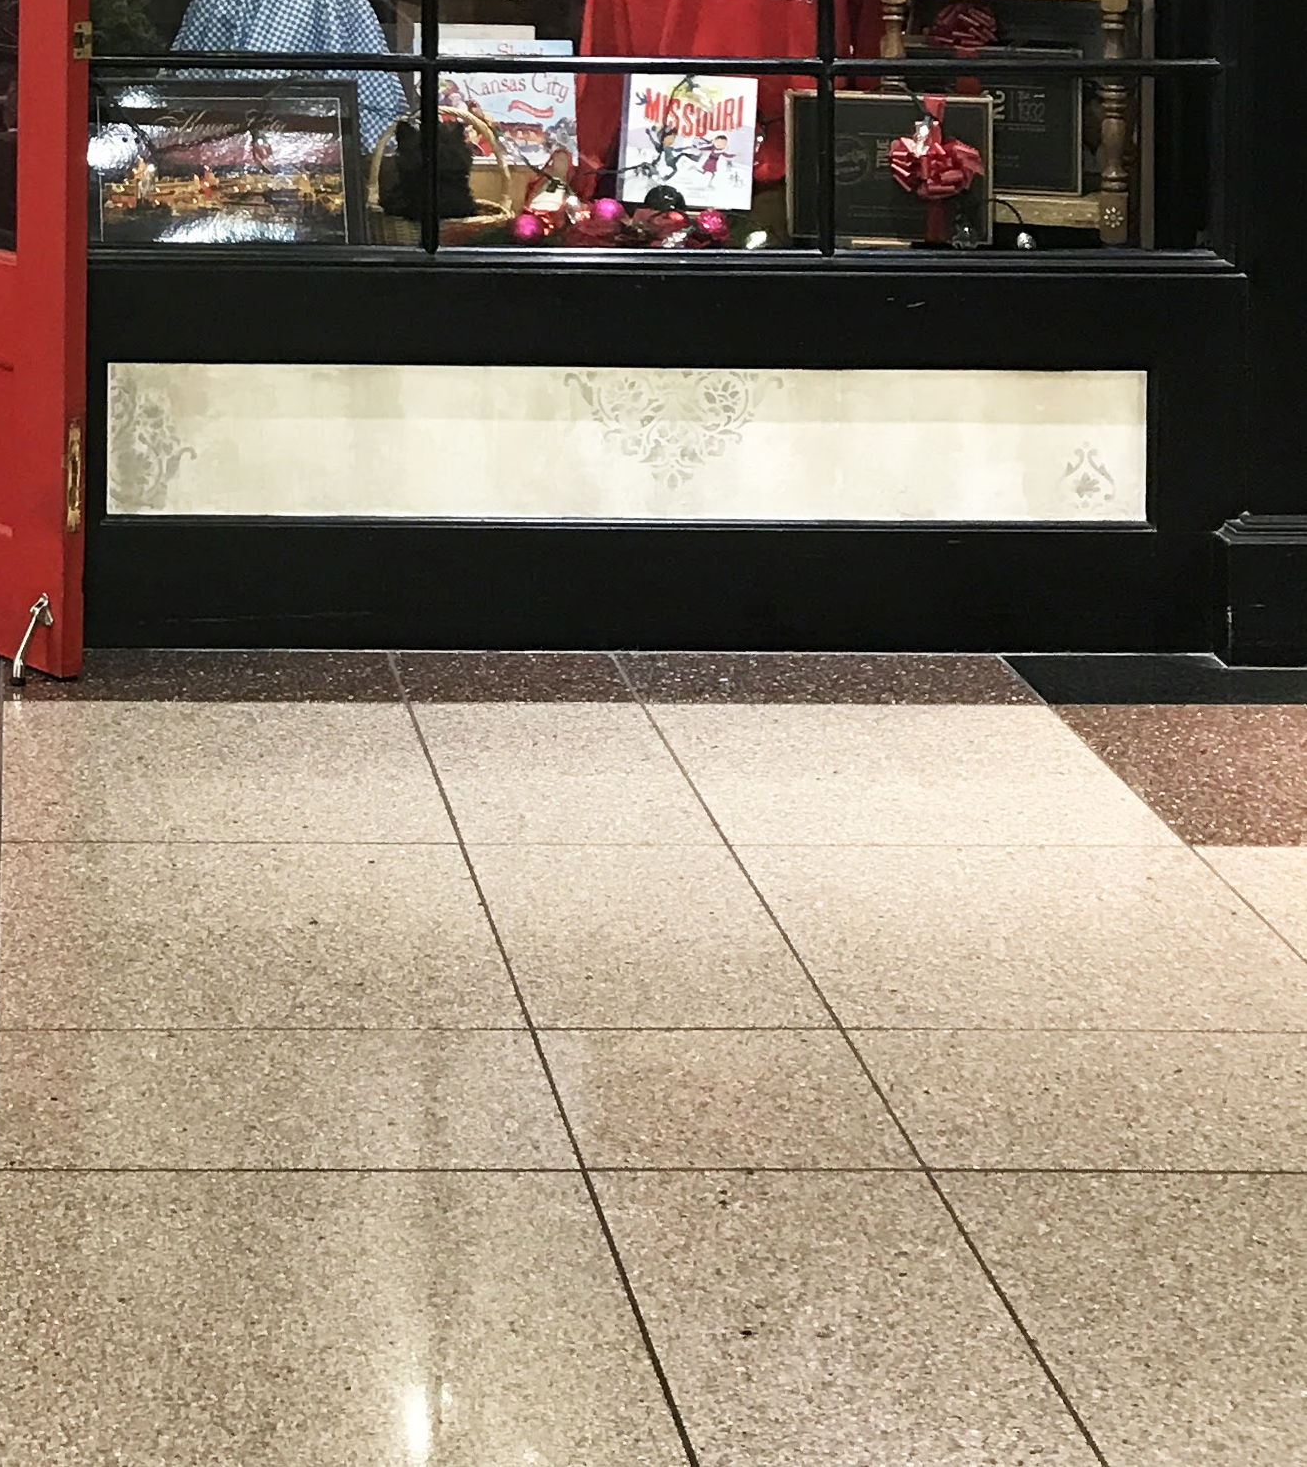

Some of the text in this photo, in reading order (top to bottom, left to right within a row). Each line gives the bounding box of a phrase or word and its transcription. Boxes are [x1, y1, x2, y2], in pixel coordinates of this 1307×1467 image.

[463, 72, 570, 103] Kansas City
[644, 87, 744, 139] MISSOURI
